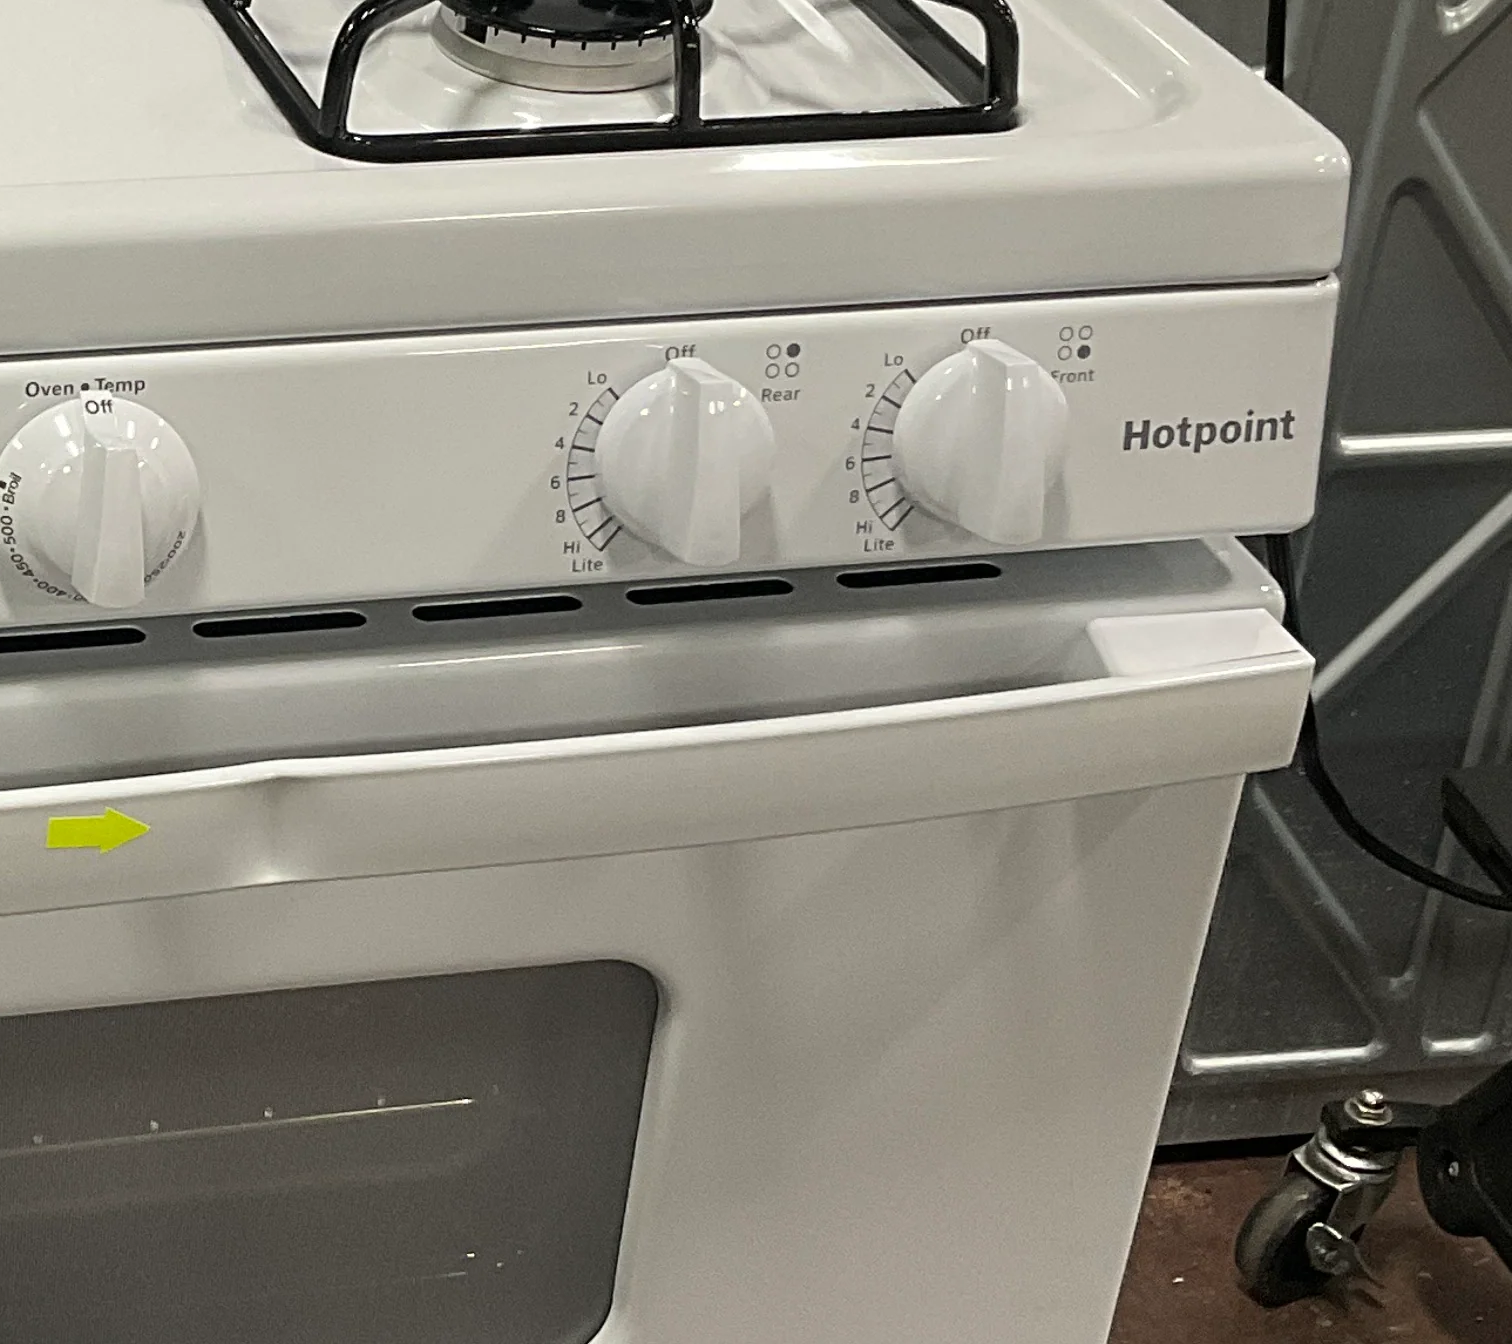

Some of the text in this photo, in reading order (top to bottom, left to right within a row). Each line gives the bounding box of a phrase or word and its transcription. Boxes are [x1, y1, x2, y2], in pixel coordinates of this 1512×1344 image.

[961, 327, 990, 344] Off
[665, 345, 696, 362] Off
[885, 353, 903, 367] Lo
[588, 371, 607, 385] Lo
[25, 378, 146, 397] Oven Temp
[866, 383, 875, 398] 2
[761, 388, 801, 403] Rear
[85, 400, 112, 414] Off
[569, 402, 579, 416] 2
[851, 418, 861, 431] 4
[1123, 409, 1295, 453] Hotpoint
[555, 436, 565, 450] 4
[846, 456, 855, 470] 6
[551, 476, 561, 490] 6
[849, 490, 859, 504] 8
[556, 510, 566, 524] 8
[856, 520, 873, 534] Hi
[0, 472, 67, 597] 400 450 500 Broil
[167, 531, 186, 559] 200
[563, 541, 580, 555] Hi
[864, 537, 895, 553] Lite
[572, 558, 604, 573] Lite
